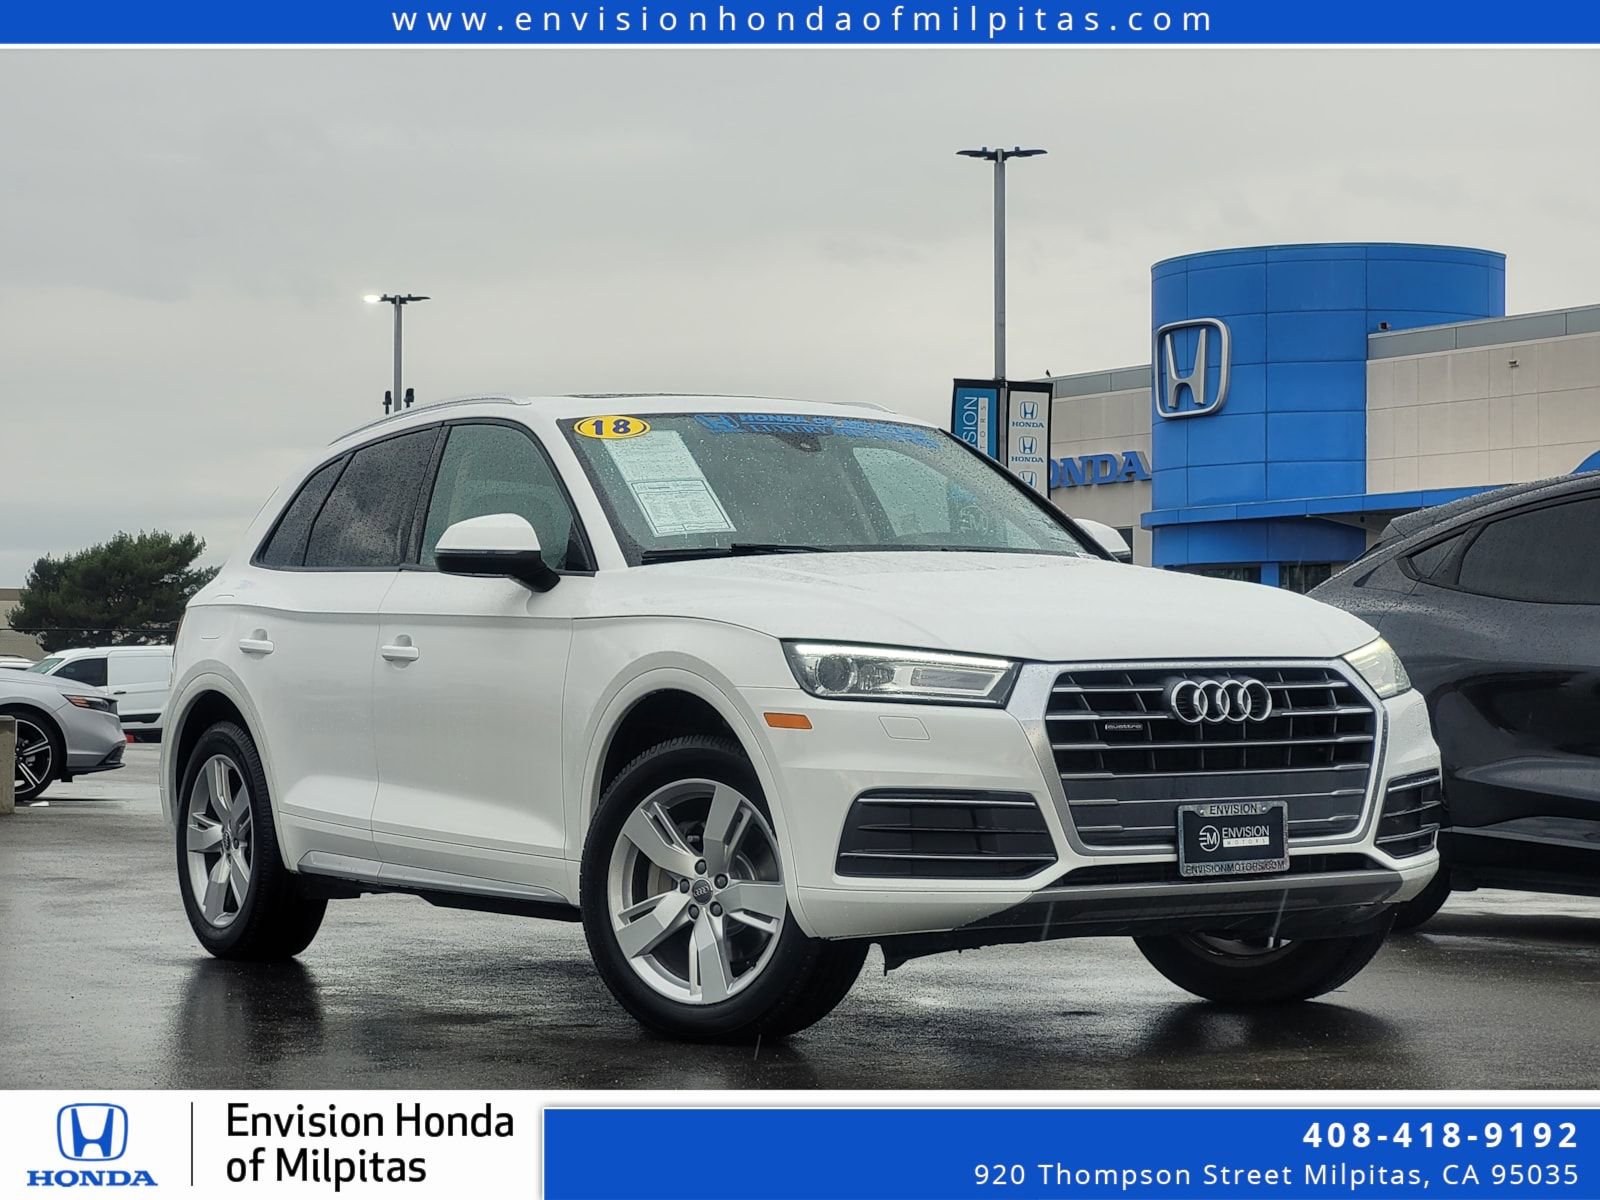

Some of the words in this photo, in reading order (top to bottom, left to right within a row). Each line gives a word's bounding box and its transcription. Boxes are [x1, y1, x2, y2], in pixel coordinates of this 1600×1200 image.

[592, 419, 631, 436] 18
[963, 397, 977, 449] SION
[1209, 803, 1257, 815] ENVISION
[1222, 825, 1270, 838] ENVISION
